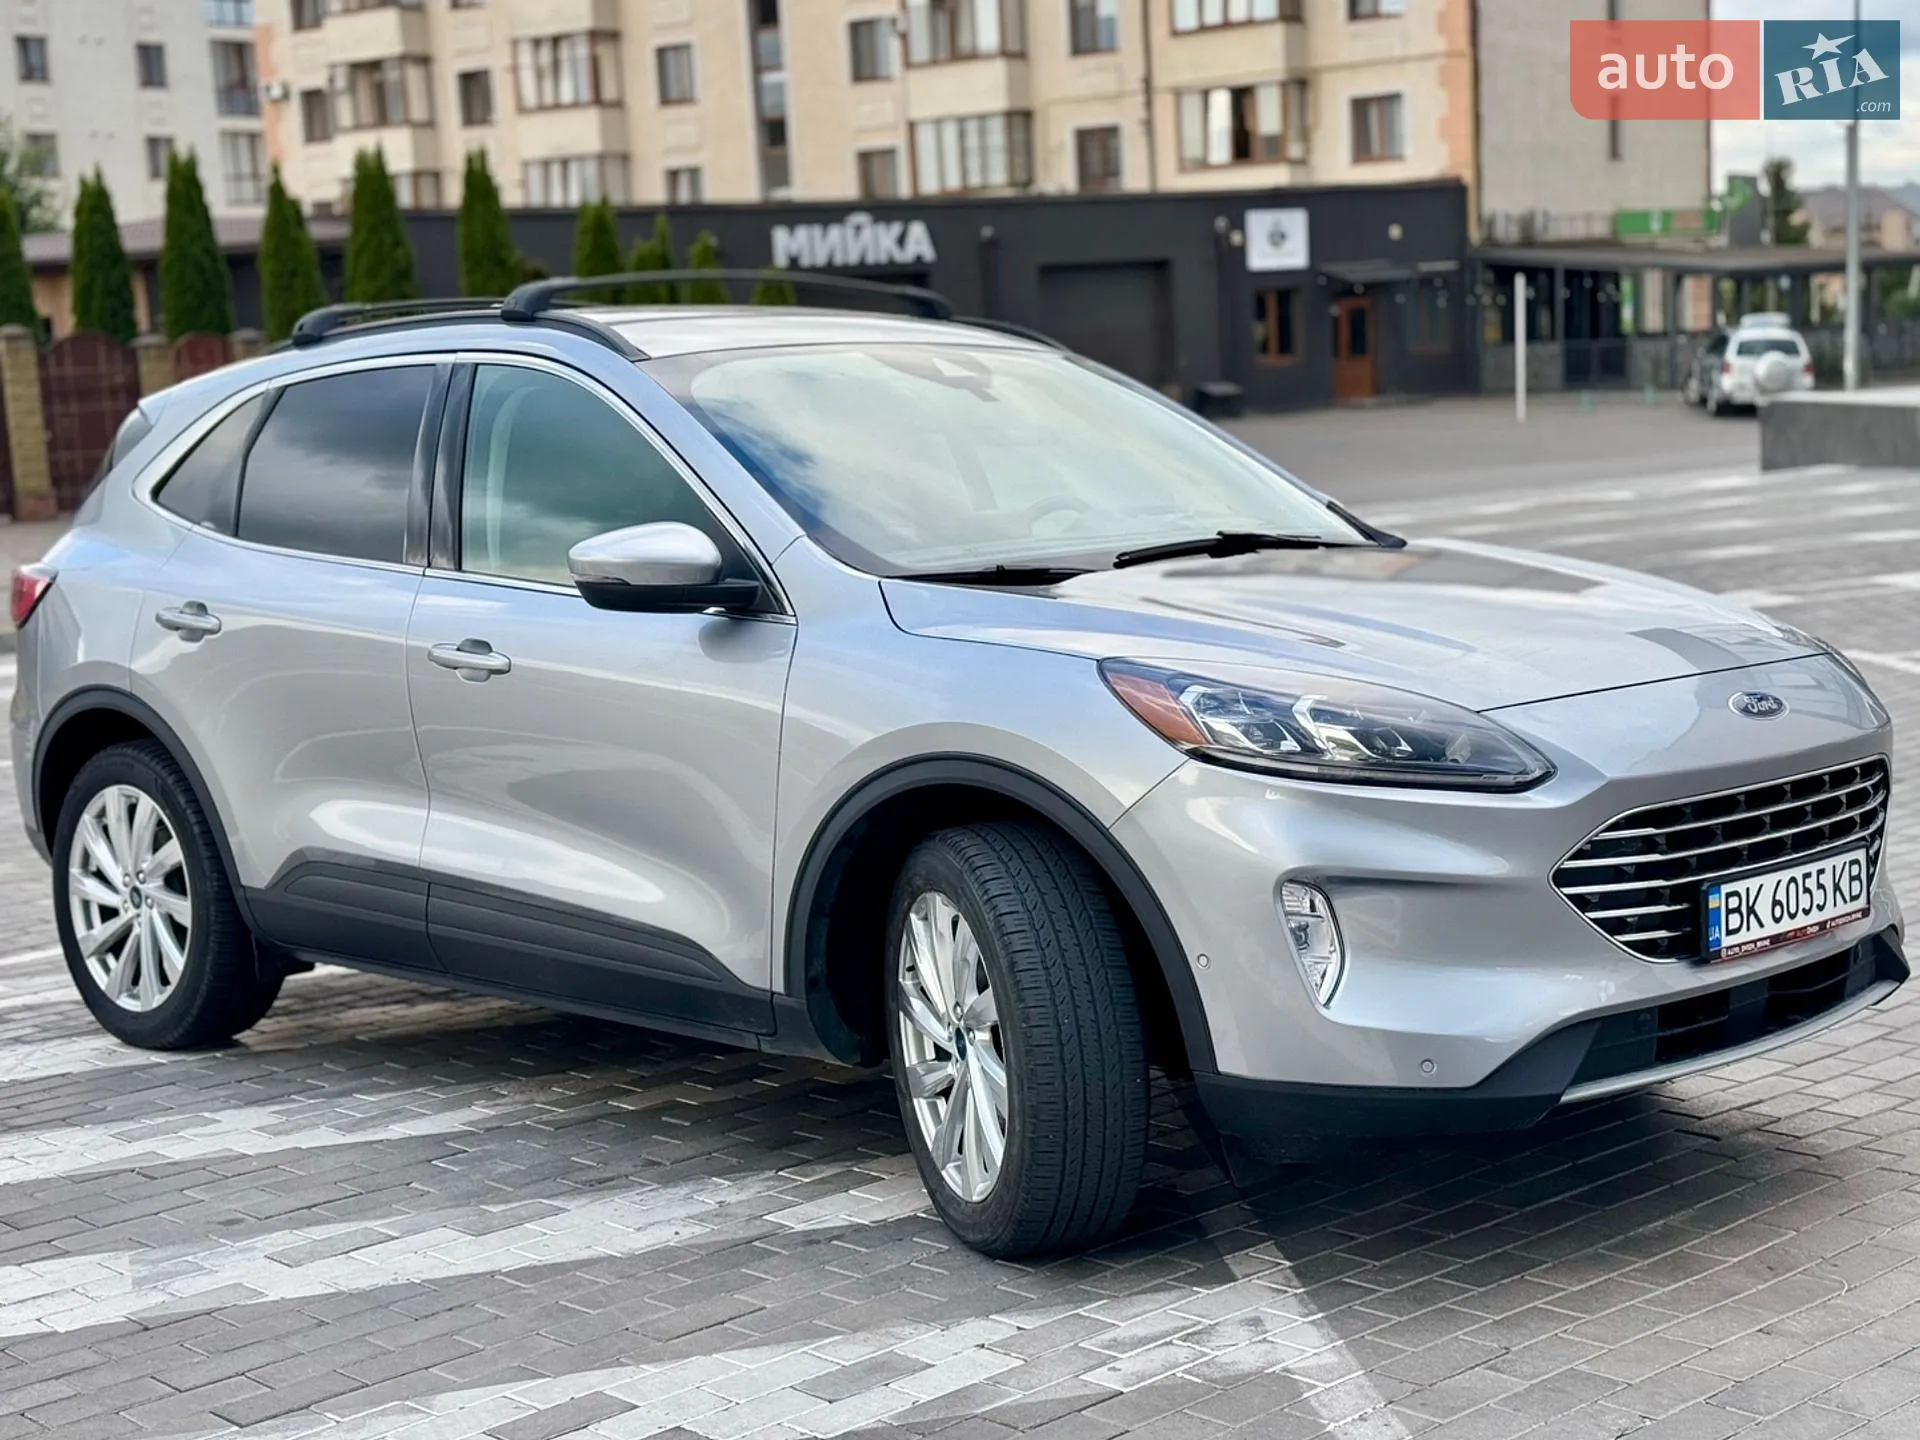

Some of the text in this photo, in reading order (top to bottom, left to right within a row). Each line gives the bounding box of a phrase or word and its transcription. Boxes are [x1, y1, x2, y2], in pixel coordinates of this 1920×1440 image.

[771, 211, 937, 269] МИЙКА
[1743, 694, 1779, 713] Ford
[1725, 858, 1863, 937] BK 6055 KB
[1708, 925, 1720, 941] UA
